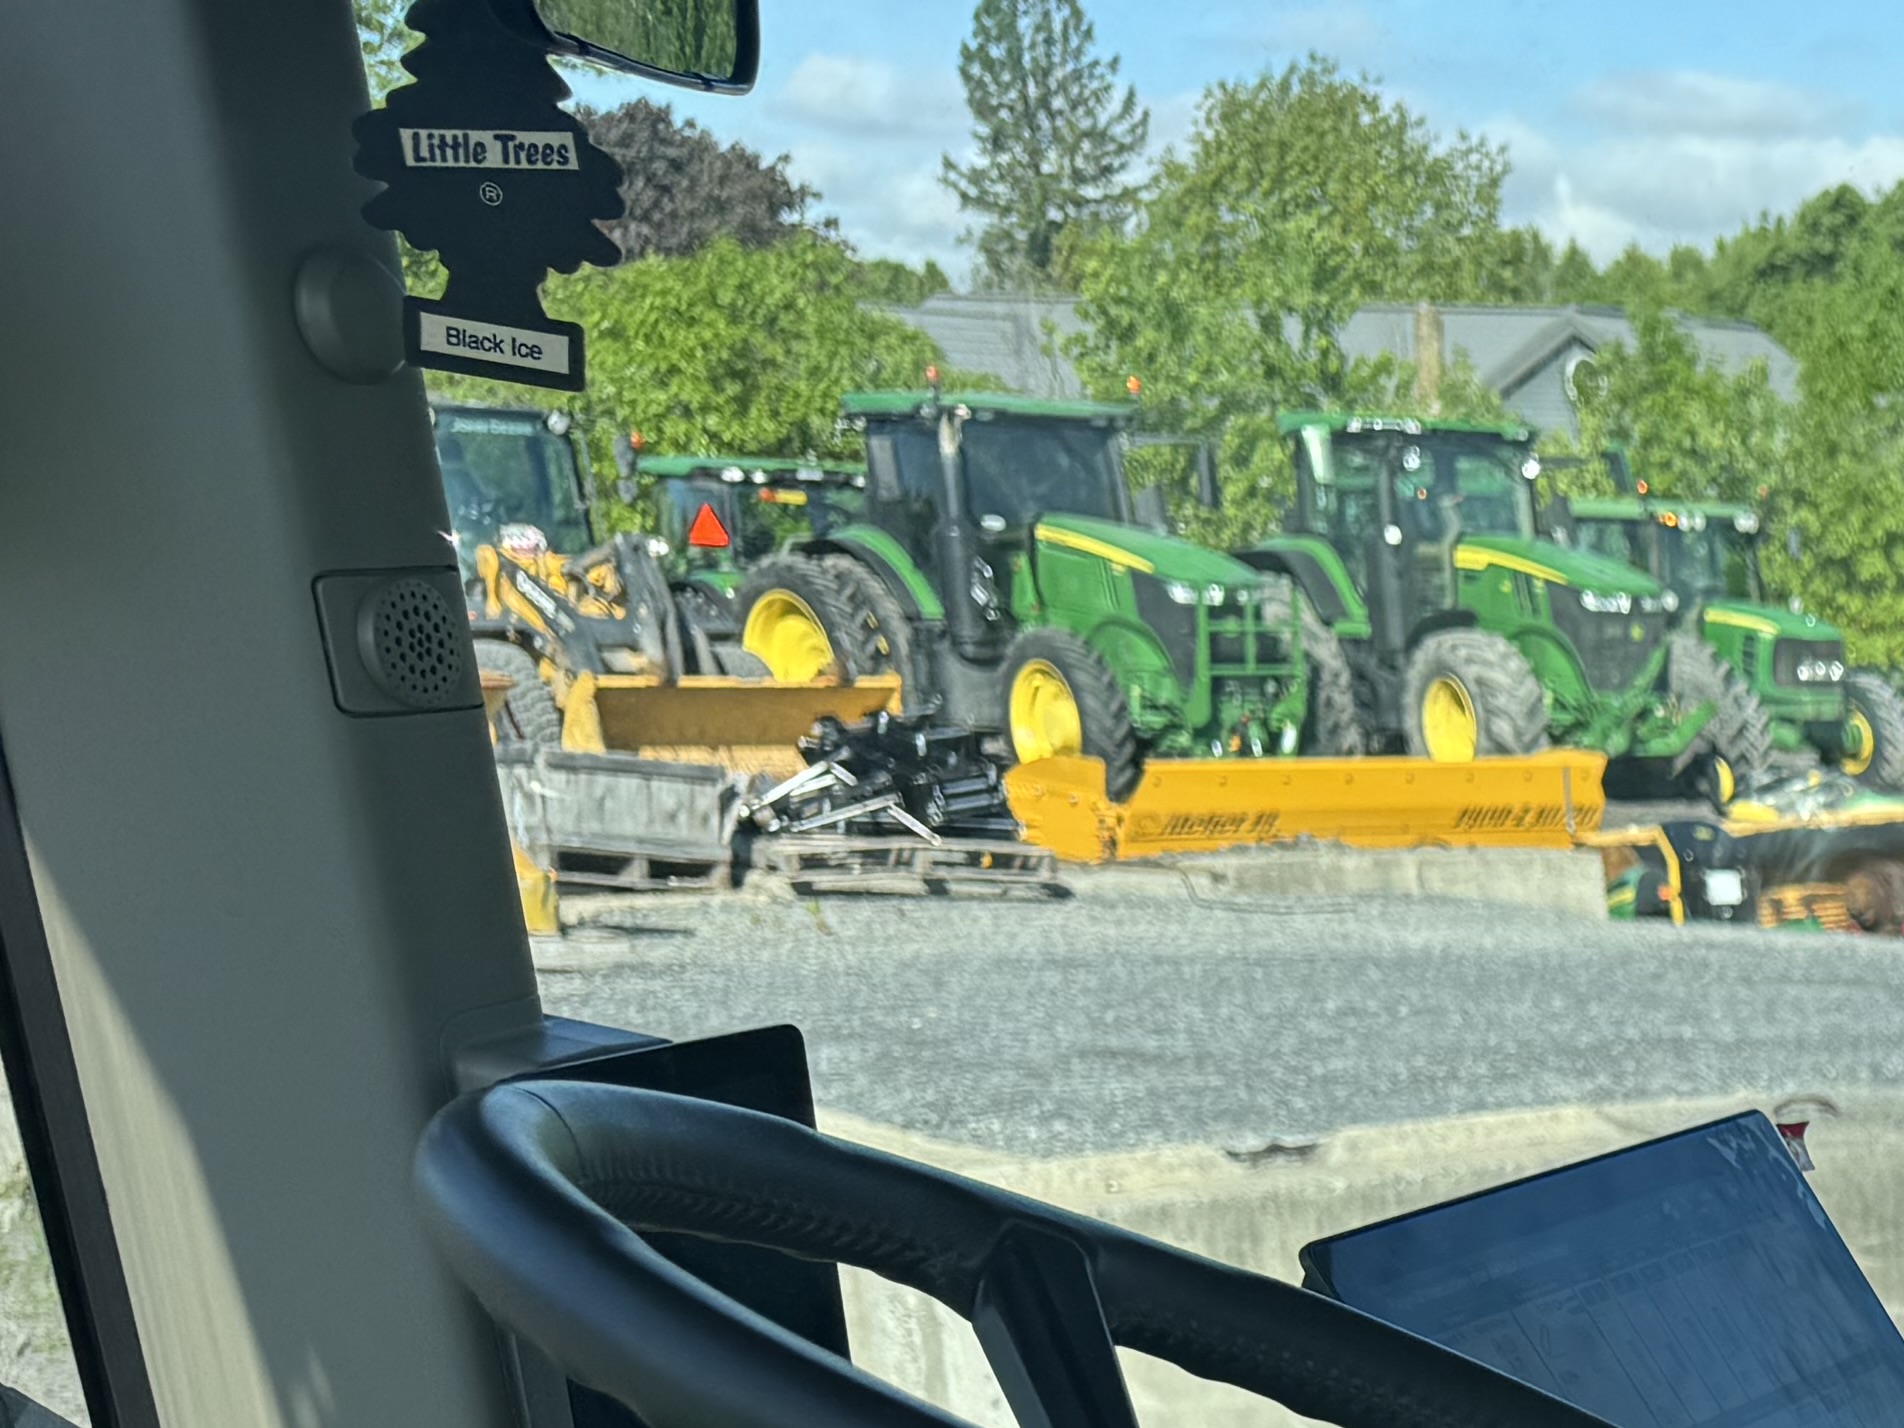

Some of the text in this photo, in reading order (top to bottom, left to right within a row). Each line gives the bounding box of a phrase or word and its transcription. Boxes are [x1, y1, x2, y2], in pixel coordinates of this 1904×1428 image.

[412, 131, 570, 166] Little Trees
[446, 326, 544, 361] Black Ice
